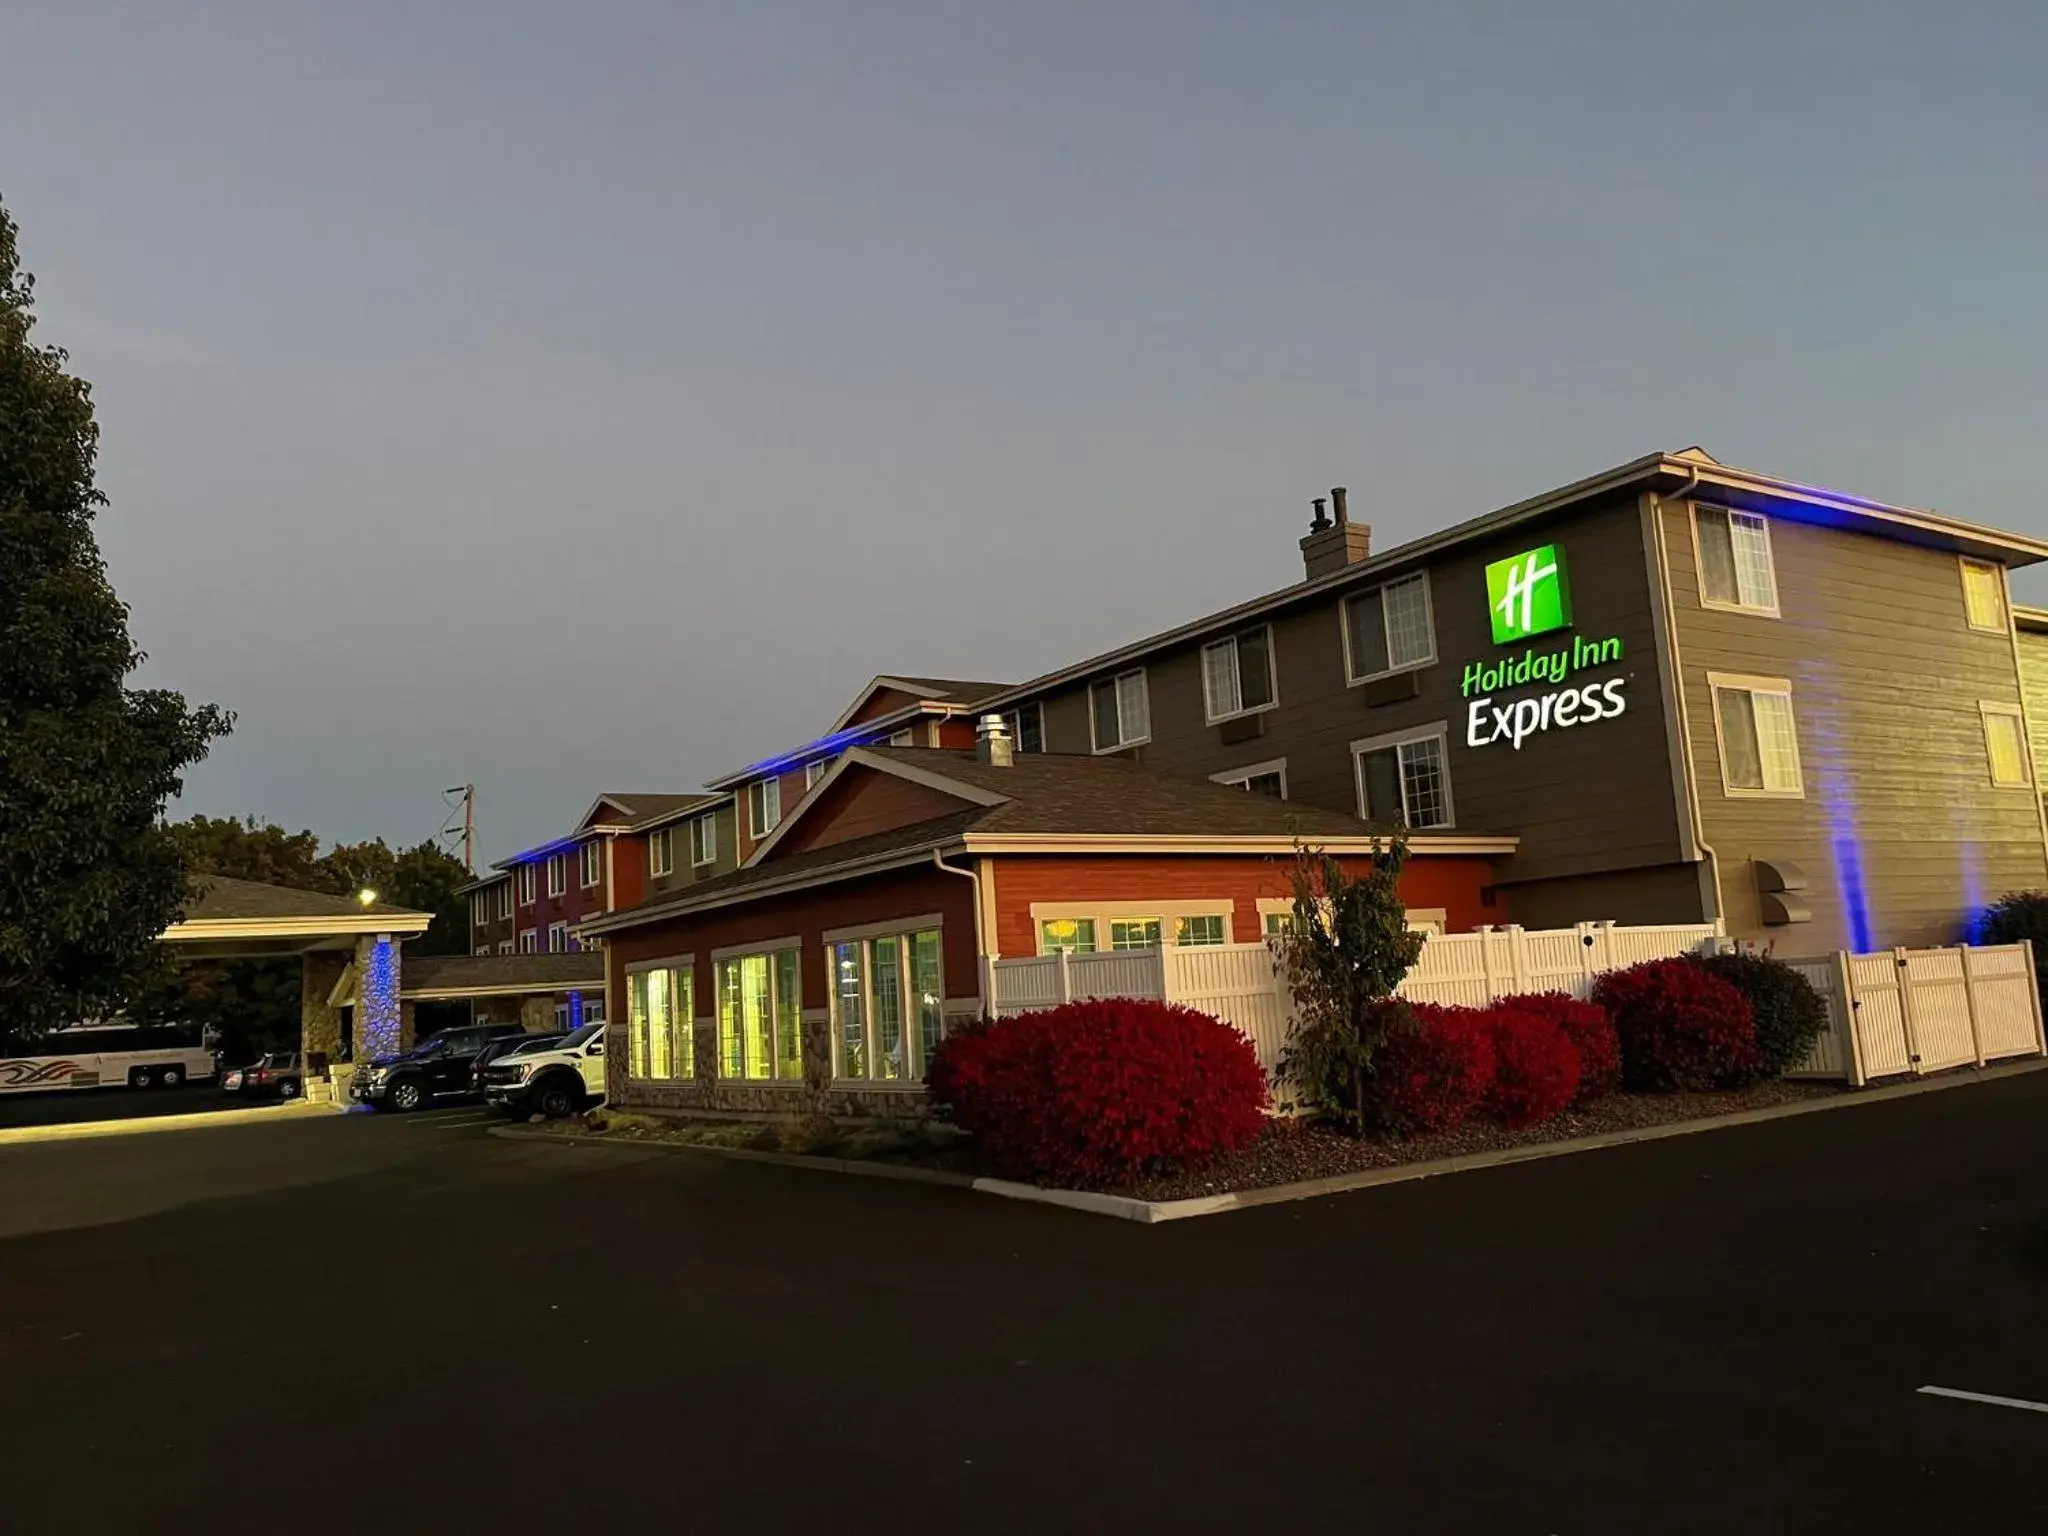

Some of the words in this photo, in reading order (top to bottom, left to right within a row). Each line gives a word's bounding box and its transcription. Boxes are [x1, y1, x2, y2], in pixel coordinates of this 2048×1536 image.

[1461, 650, 1568, 697] Holiday
[1573, 635, 1621, 670] Inn
[1467, 678, 1626, 750] Express
